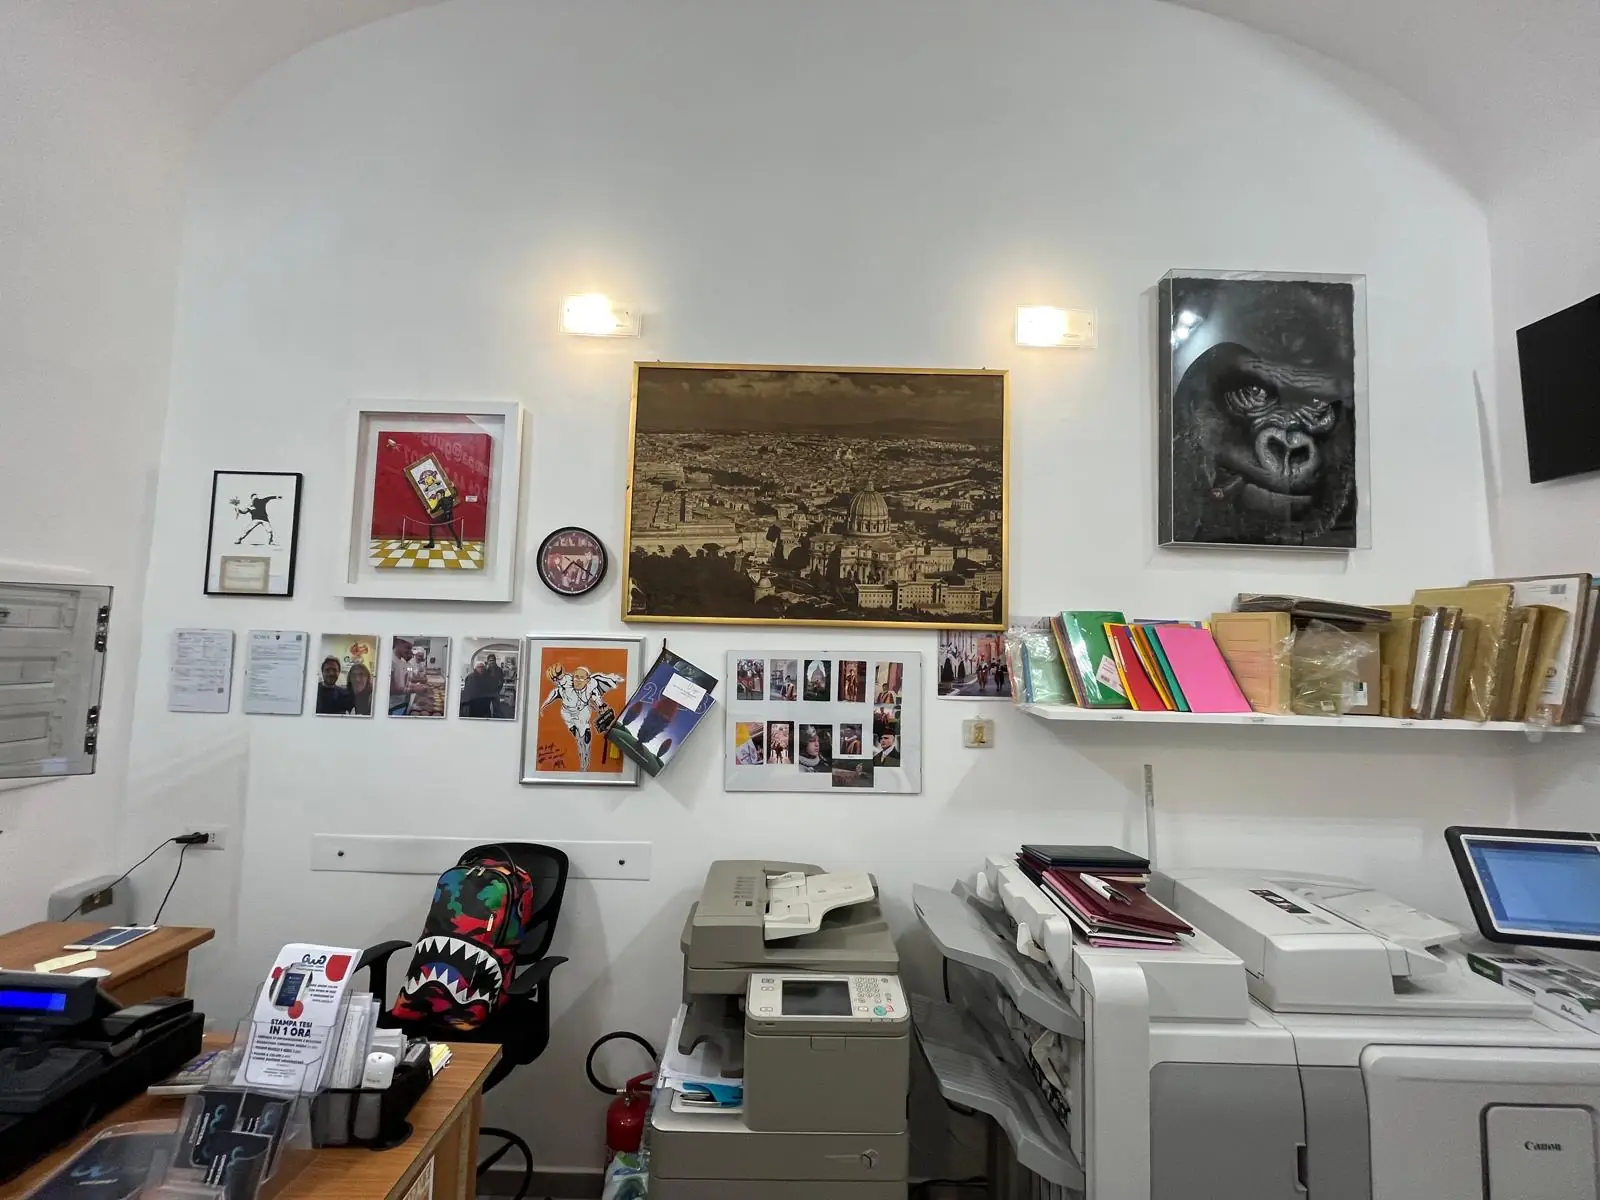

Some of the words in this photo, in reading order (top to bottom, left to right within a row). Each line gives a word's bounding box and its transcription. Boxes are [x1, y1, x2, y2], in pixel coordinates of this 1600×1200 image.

[270, 1018, 297, 1027] STAMPA
[299, 1020, 313, 1028] TESI
[269, 1025, 280, 1035] IN
[283, 1026, 288, 1035] 1
[290, 1027, 311, 1038] ORA
[1524, 1140, 1562, 1151] Canon
